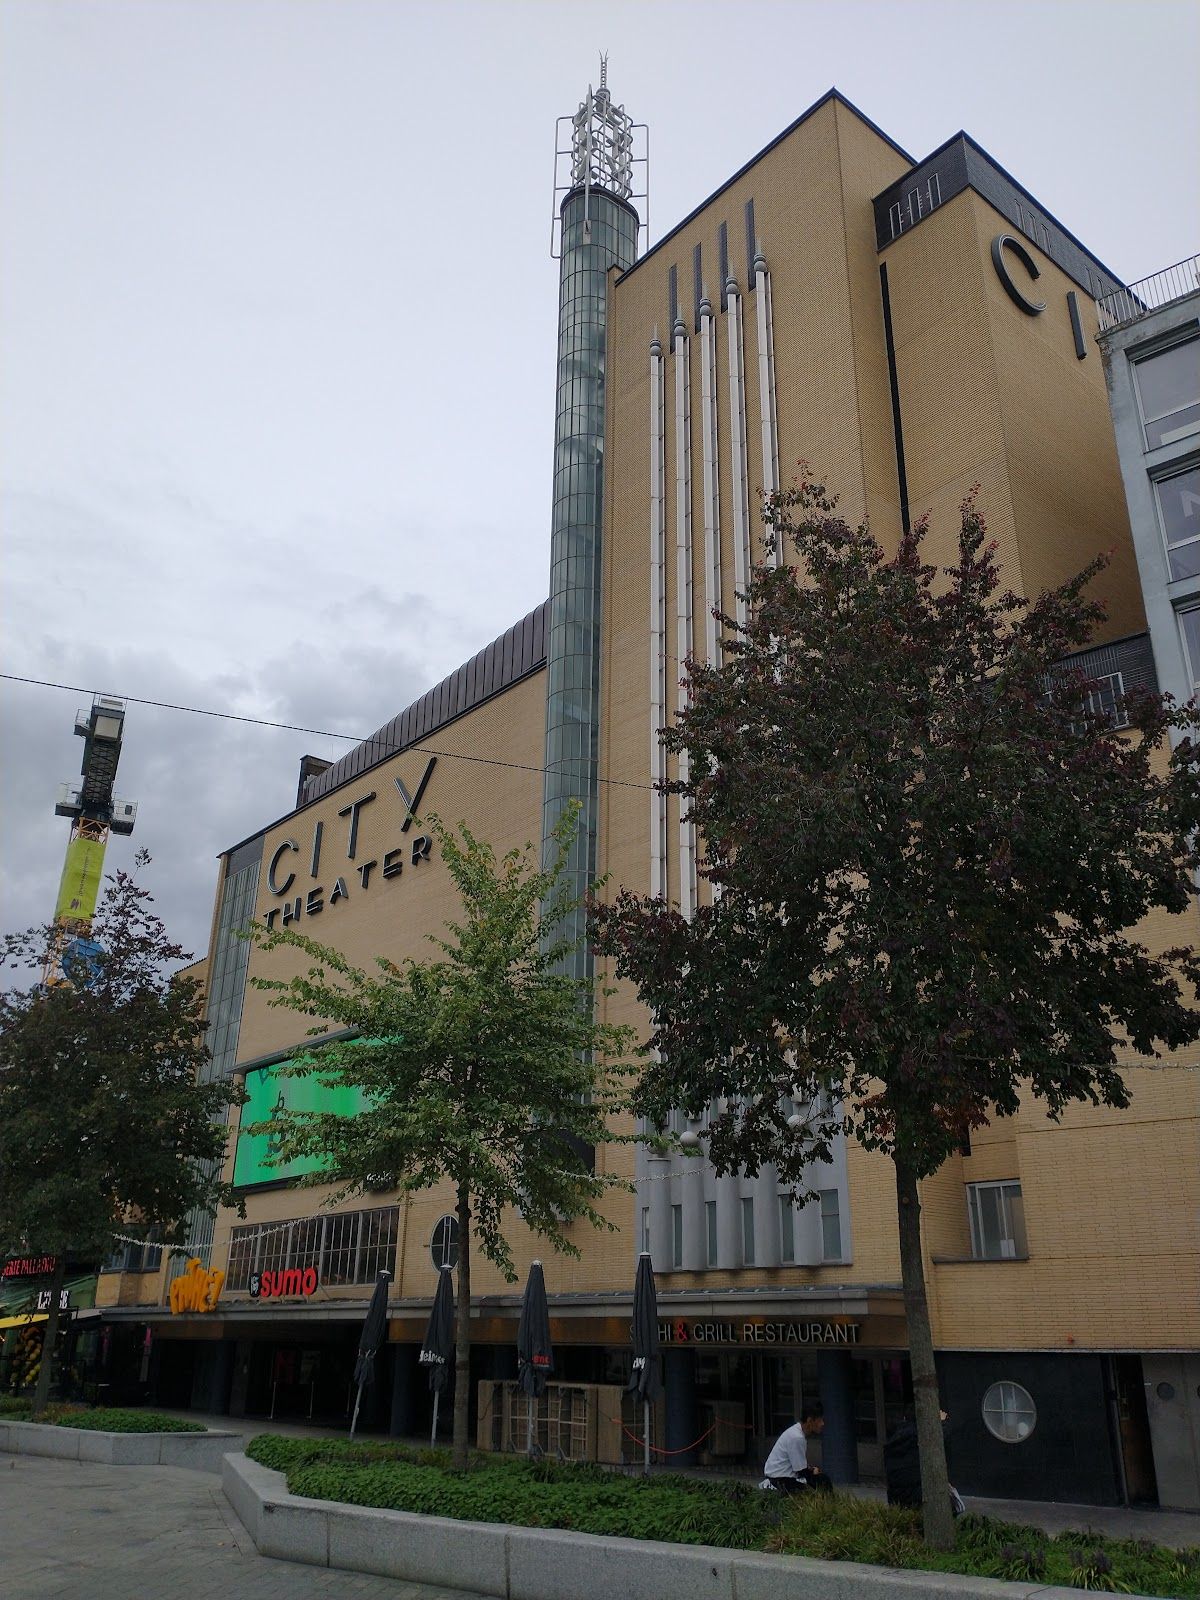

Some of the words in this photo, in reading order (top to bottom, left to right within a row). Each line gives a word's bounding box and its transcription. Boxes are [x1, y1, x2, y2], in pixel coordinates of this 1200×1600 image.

[268, 757, 438, 897] CITY
[263, 835, 433, 930] THEATER
[674, 1321, 688, 1344] &
[693, 1323, 737, 1343] GRILL
[743, 1323, 860, 1344] RESTAURANT
